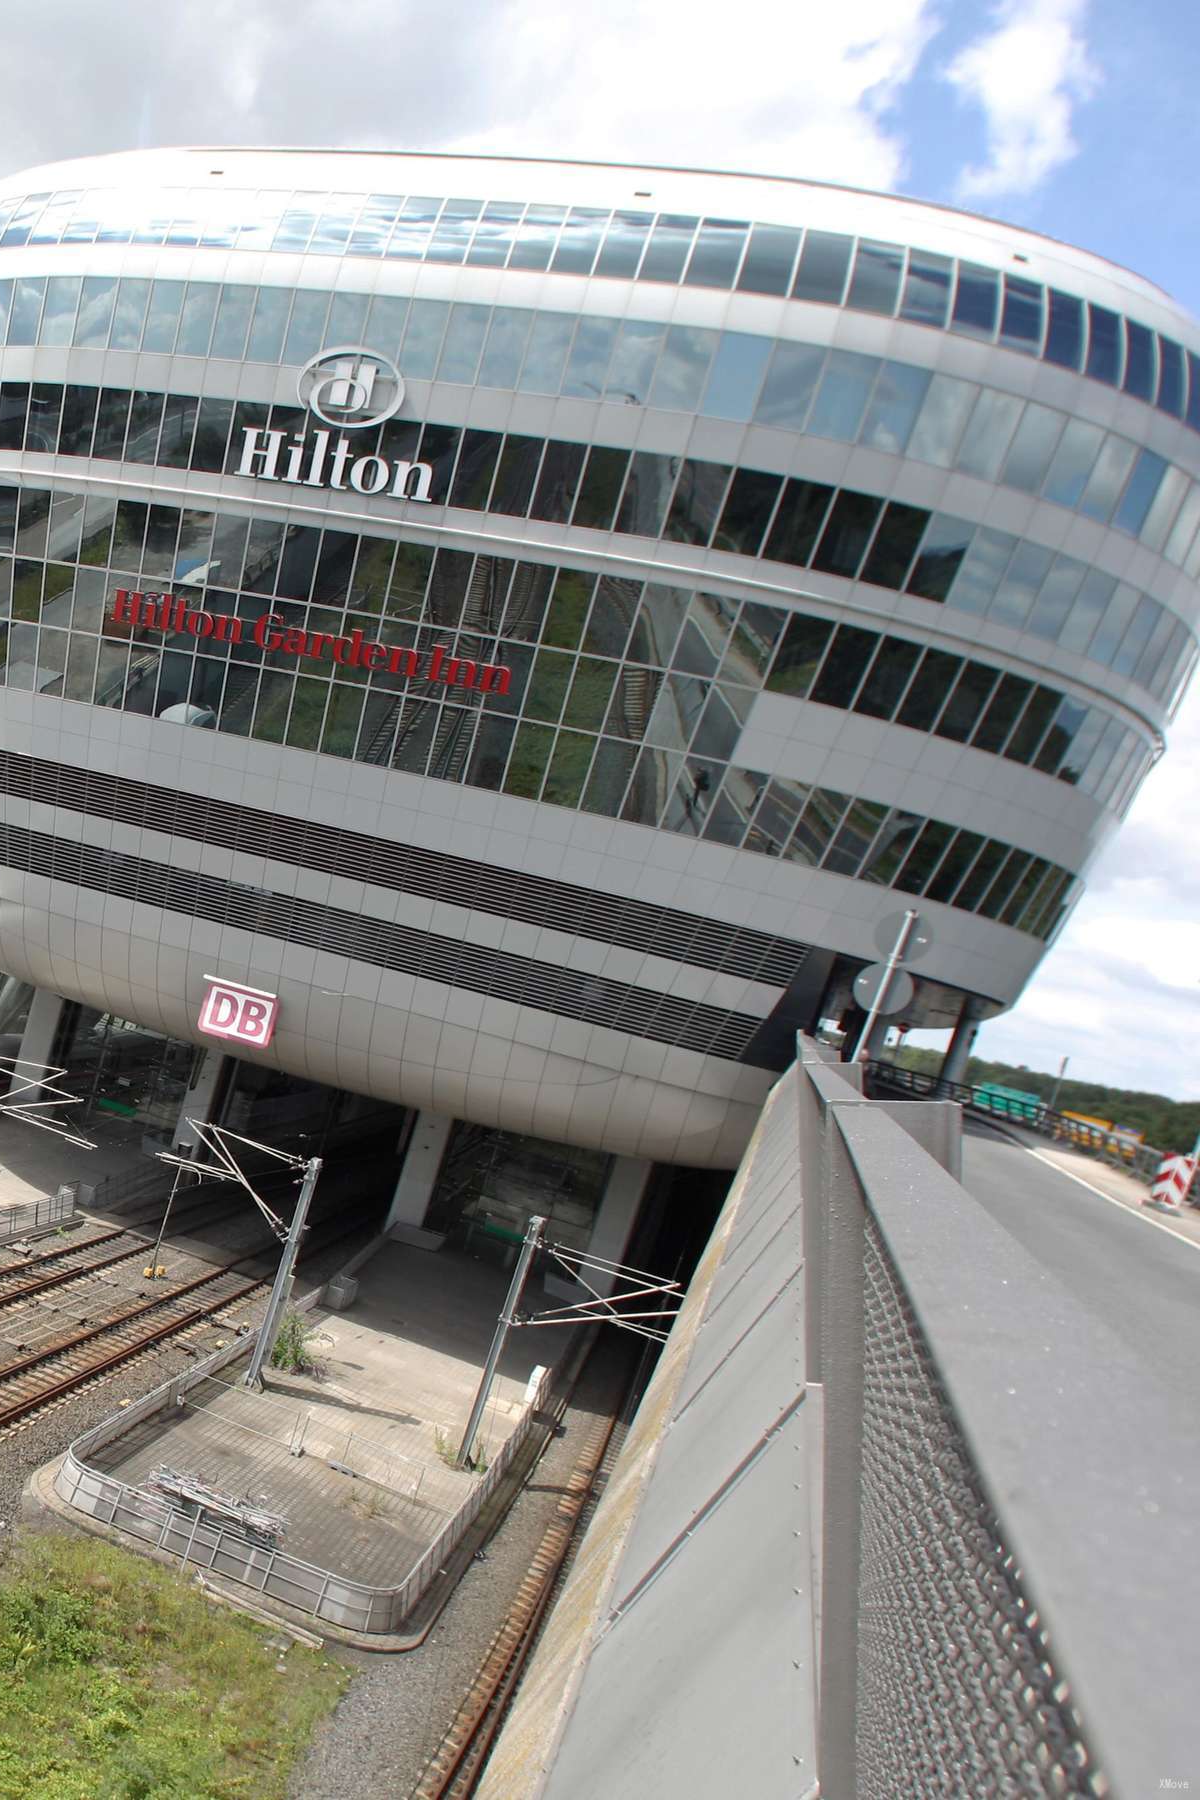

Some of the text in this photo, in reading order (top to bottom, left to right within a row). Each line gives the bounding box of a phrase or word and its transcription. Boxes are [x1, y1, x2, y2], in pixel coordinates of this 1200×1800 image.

[234, 426, 433, 503] Hilton
[111, 588, 512, 696] Hilton Garden Inn
[208, 990, 268, 1038] DB
